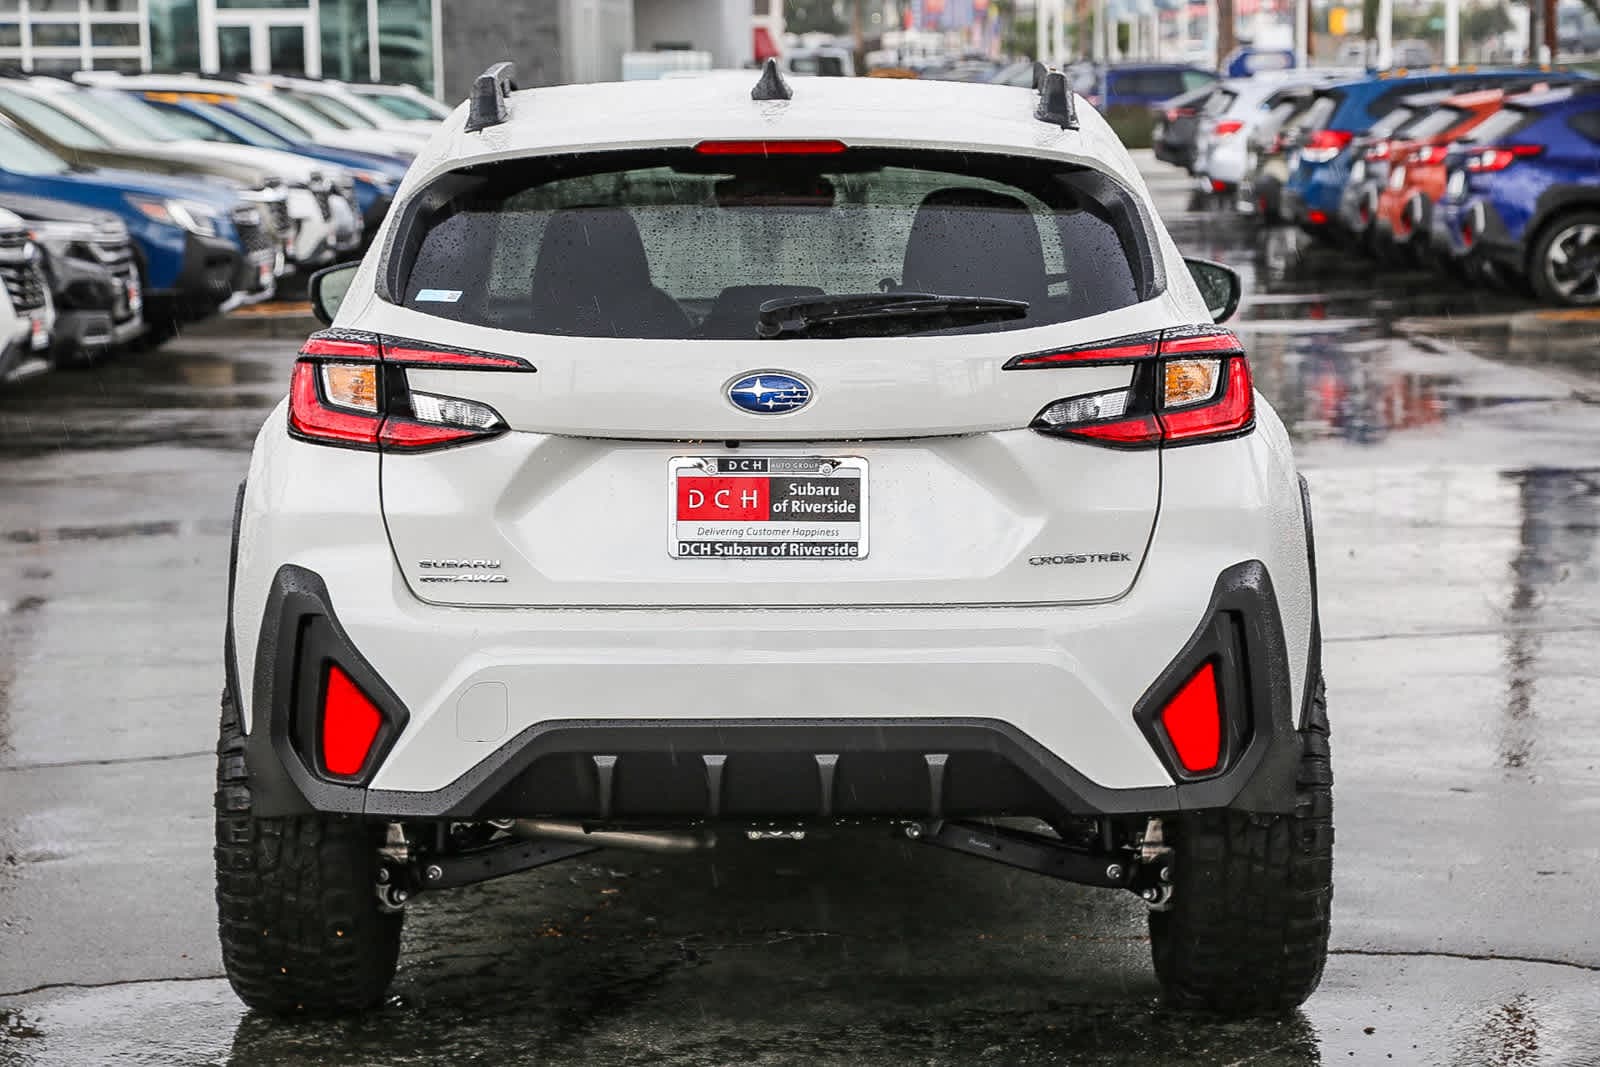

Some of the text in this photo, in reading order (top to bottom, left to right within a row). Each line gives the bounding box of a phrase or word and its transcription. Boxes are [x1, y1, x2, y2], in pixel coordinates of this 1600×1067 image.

[728, 460, 762, 470] DCH
[771, 462, 791, 470] AUTO
[789, 482, 839, 496] Subaru
[688, 489, 758, 509] DCH
[772, 499, 857, 513] of Riverside
[697, 526, 840, 538] Delivering Customer Happiness
[679, 542, 858, 556] DCH Subaru of Riverside
[418, 558, 501, 569] SUBARU
[1028, 552, 1131, 566] CROSSTREK
